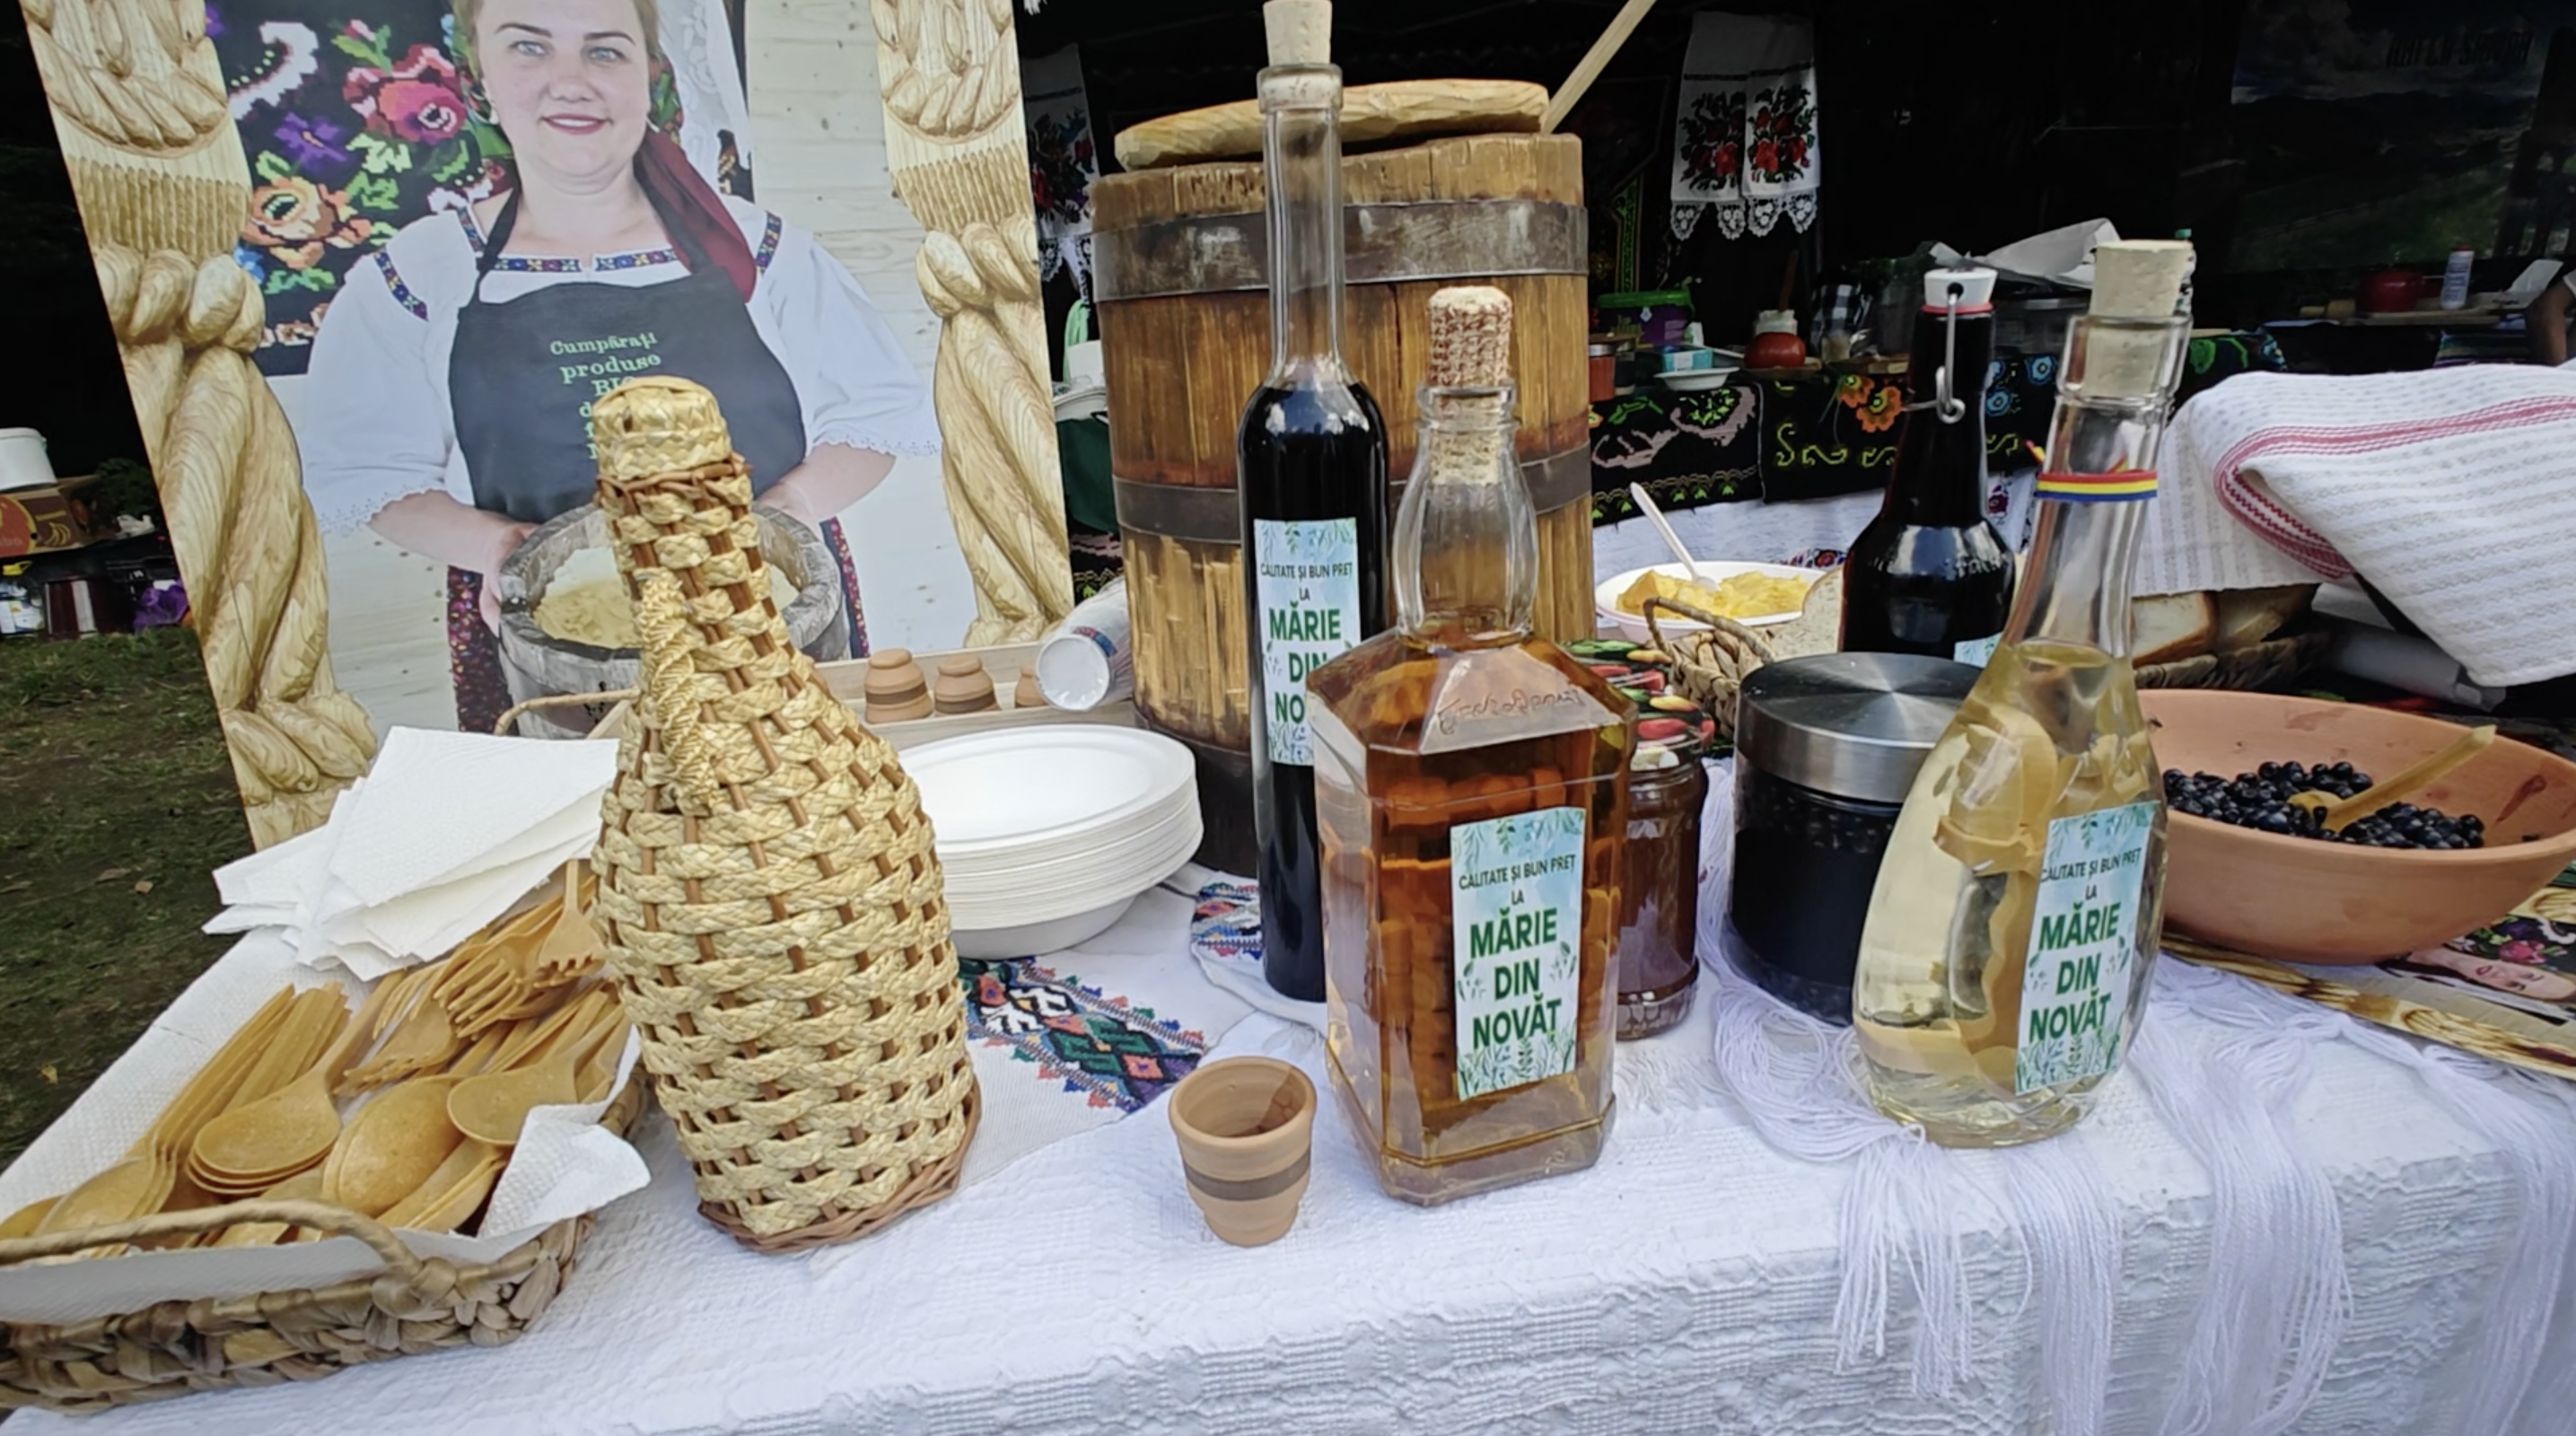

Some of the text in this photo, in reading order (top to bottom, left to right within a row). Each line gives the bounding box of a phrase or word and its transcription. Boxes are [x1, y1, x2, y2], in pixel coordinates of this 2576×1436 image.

[559, 354, 662, 384] produse
[591, 376, 635, 397] BI
[1260, 562, 1295, 579] CALITATE
[1309, 564, 1330, 579] BUN
[1299, 586, 1310, 601] LA
[1268, 600, 1341, 642] MĂRIE
[1459, 866, 1508, 890] CALITATE
[1523, 859, 1547, 880] BUN
[2100, 854, 2121, 874] BUN
[1511, 889, 1524, 906] LA
[2085, 884, 2097, 901] LA
[1470, 906, 1557, 960] MĂRIE
[2038, 901, 2121, 951] MĂRIE
[1494, 958, 1539, 1001] DIN
[2055, 952, 2101, 995] DIN
